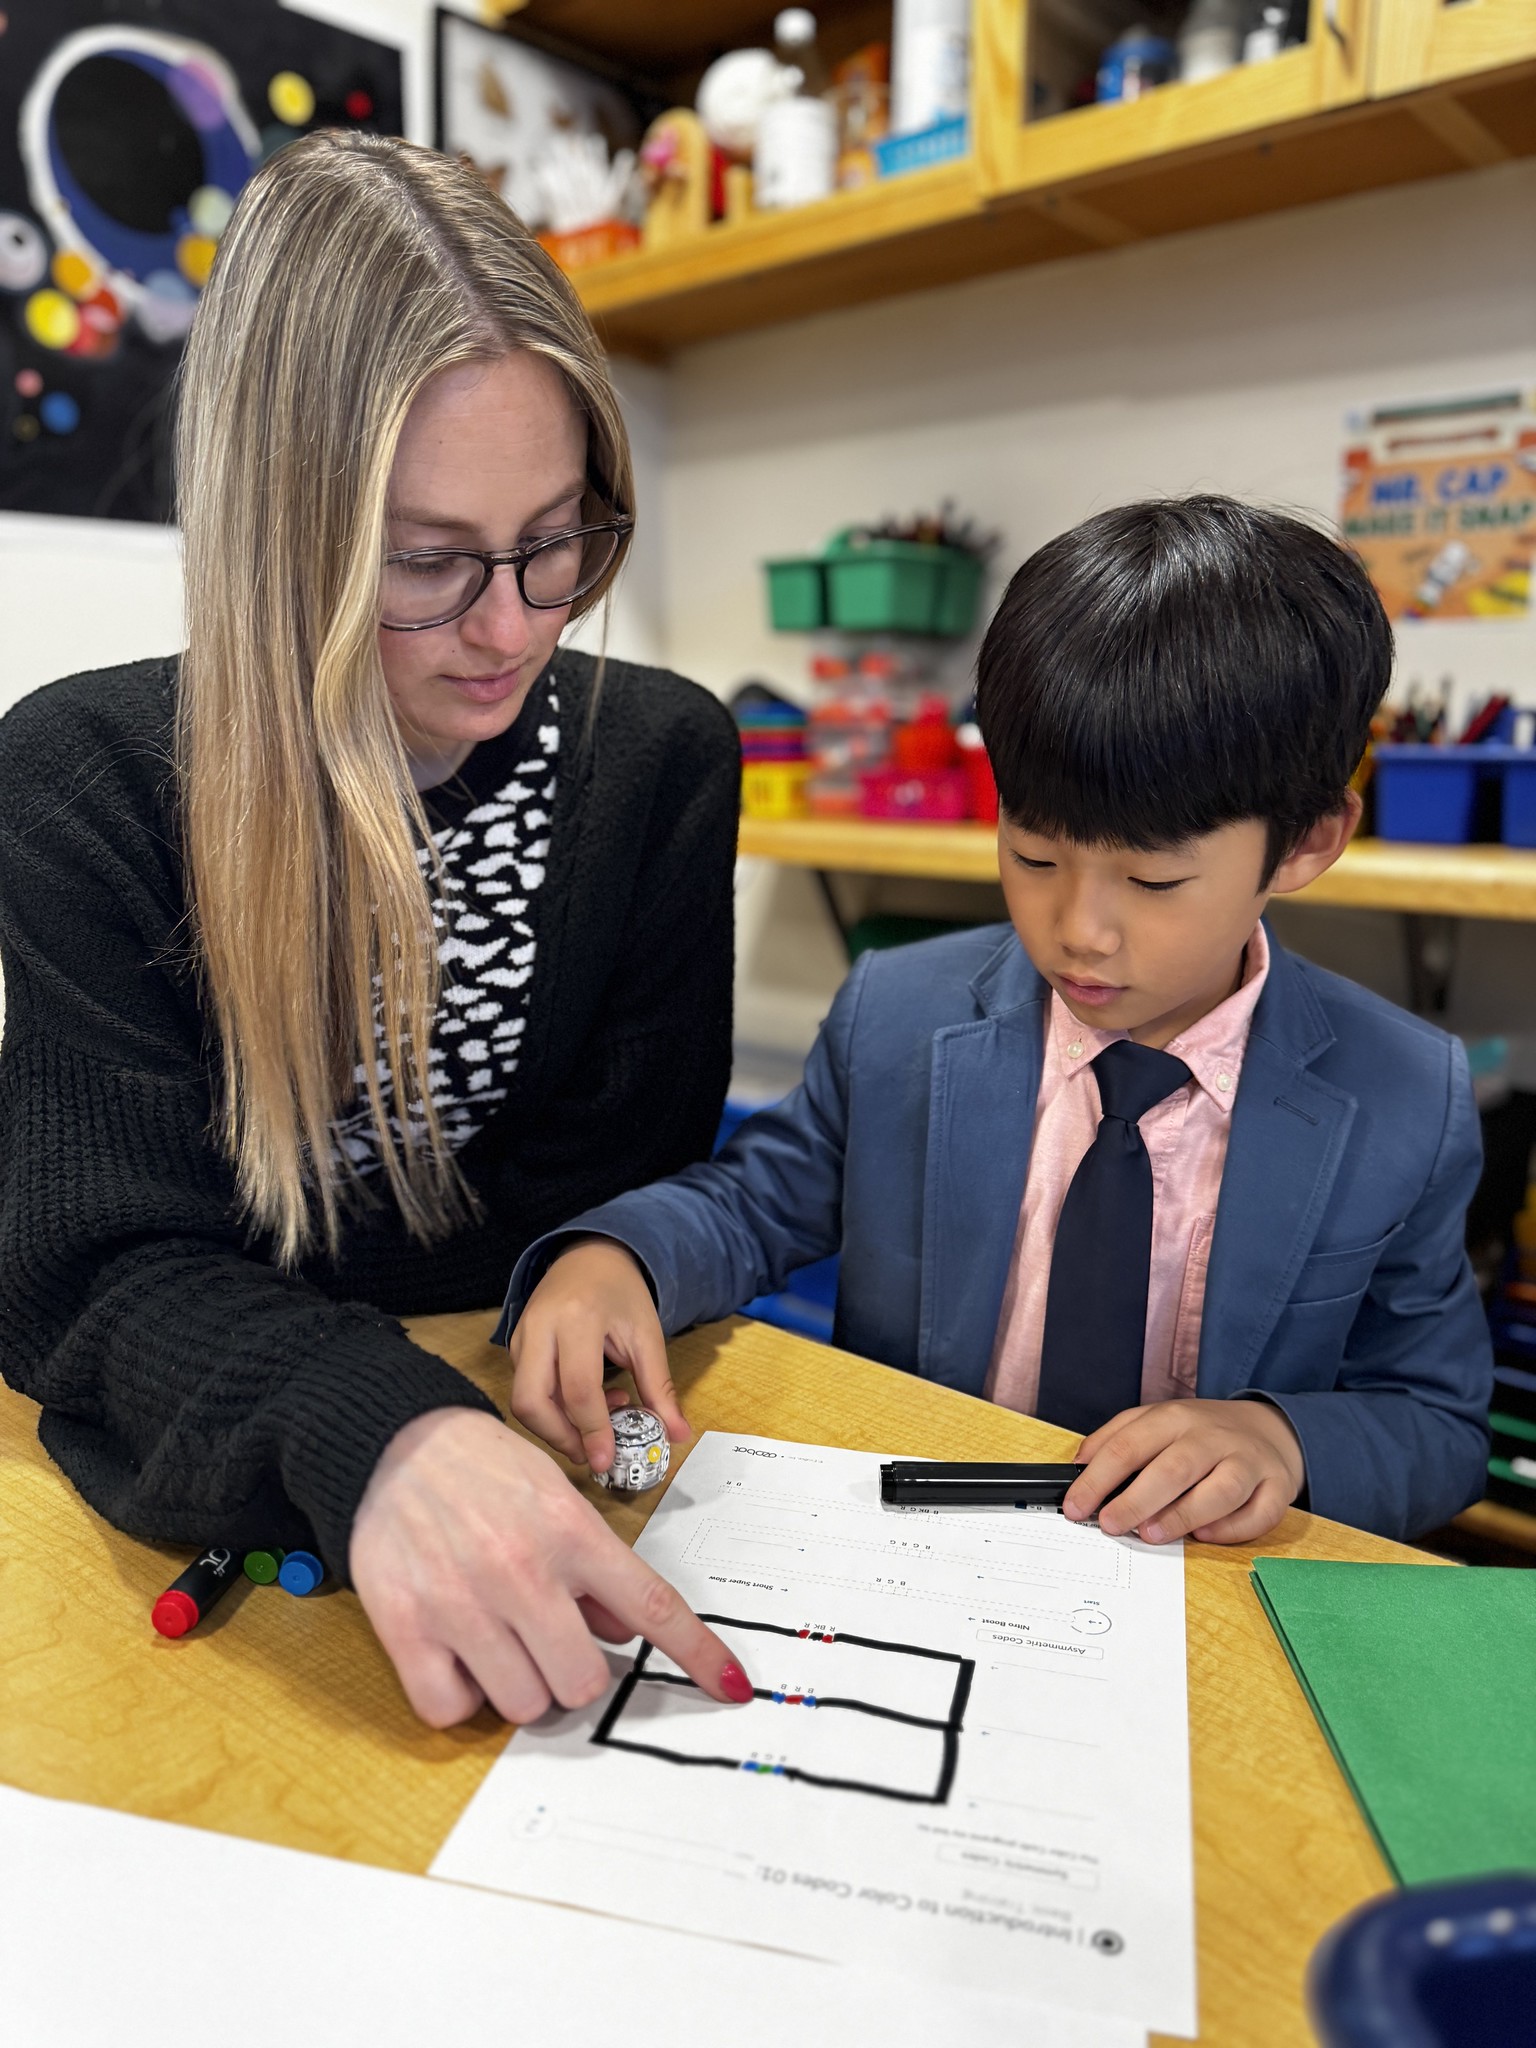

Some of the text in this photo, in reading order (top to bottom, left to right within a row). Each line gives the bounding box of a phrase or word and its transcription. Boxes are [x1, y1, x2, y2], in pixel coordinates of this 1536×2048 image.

[1437, 464, 1507, 501] CAP
[733, 1446, 777, 1458] ozobot
[708, 1576, 774, 1591] Short Super Slow
[813, 1623, 826, 1631] BK
[982, 1618, 1030, 1631] Nitro Boost
[992, 1633, 1086, 1655] Asymmetric Codes
[961, 1851, 1068, 1880] Symmetric Codes
[792, 1872, 852, 1898] Codes
[858, 1886, 912, 1912] Color
[917, 1897, 938, 1916] to
[944, 1903, 1072, 1943] Introduction
